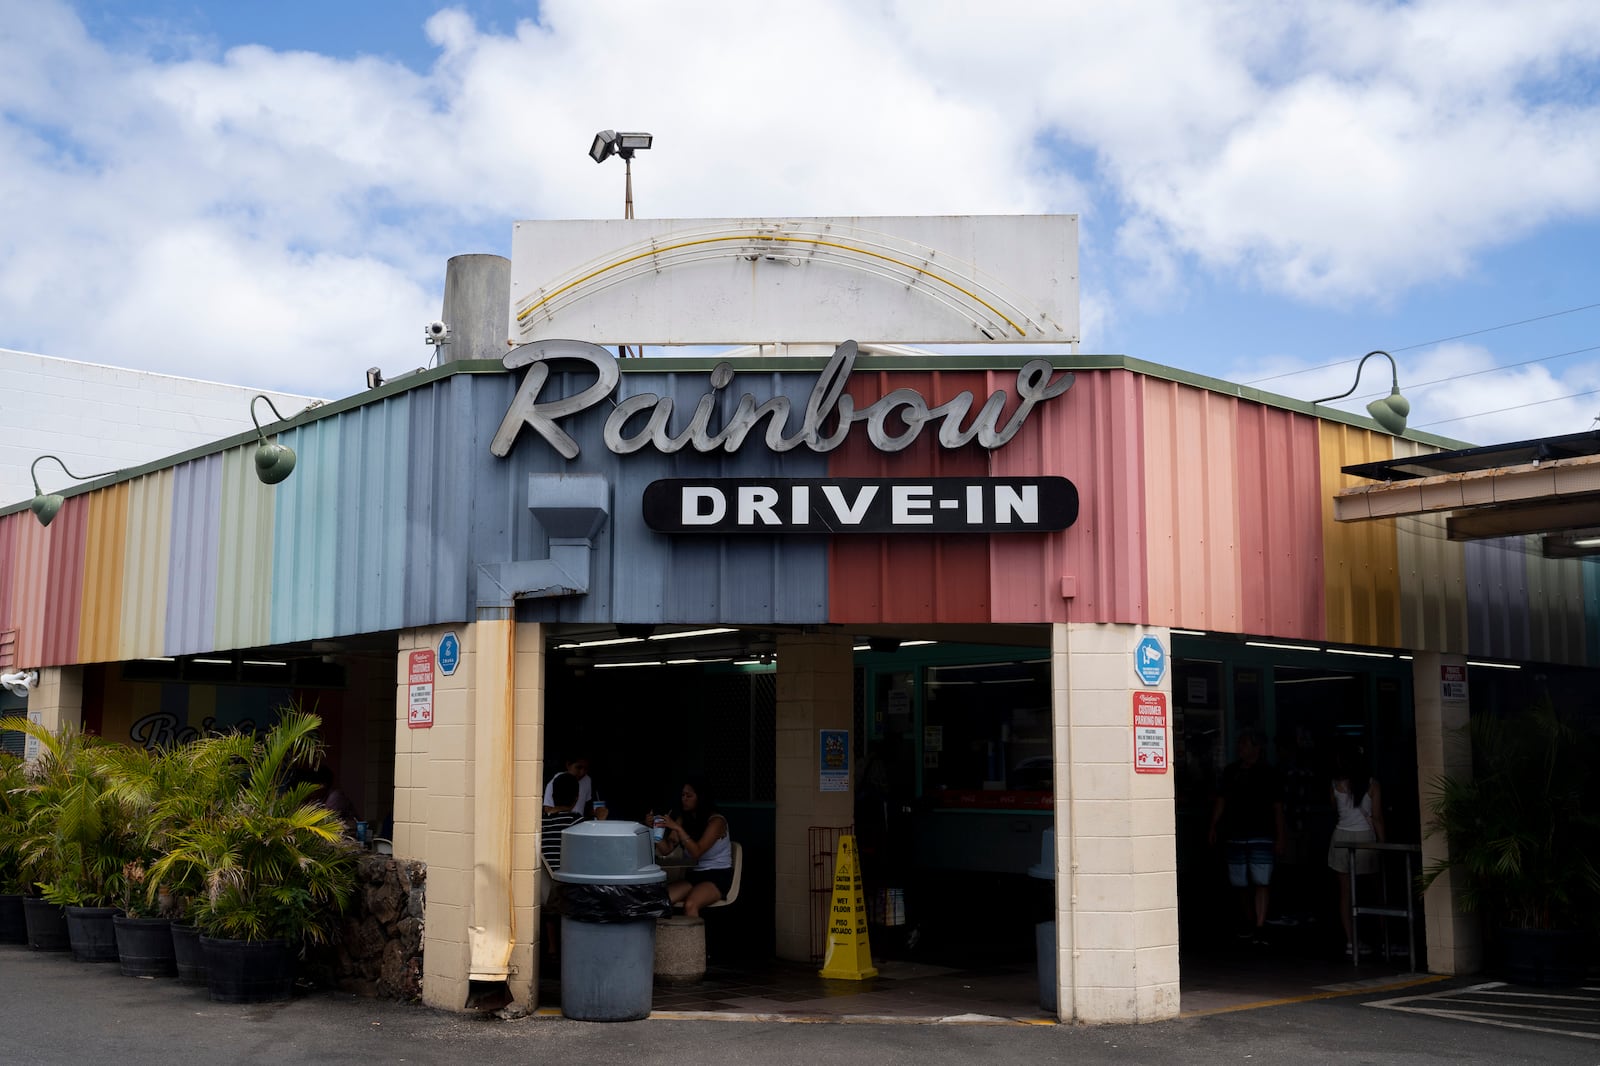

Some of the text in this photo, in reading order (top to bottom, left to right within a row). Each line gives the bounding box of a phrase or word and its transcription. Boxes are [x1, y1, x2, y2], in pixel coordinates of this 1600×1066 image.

[489, 338, 1076, 460] Rainbow
[681, 485, 1039, 526] DRIVE-IN
[833, 905, 851, 913] FLOOR
[835, 919, 848, 927] PISO
[831, 927, 853, 935] MOJADO
